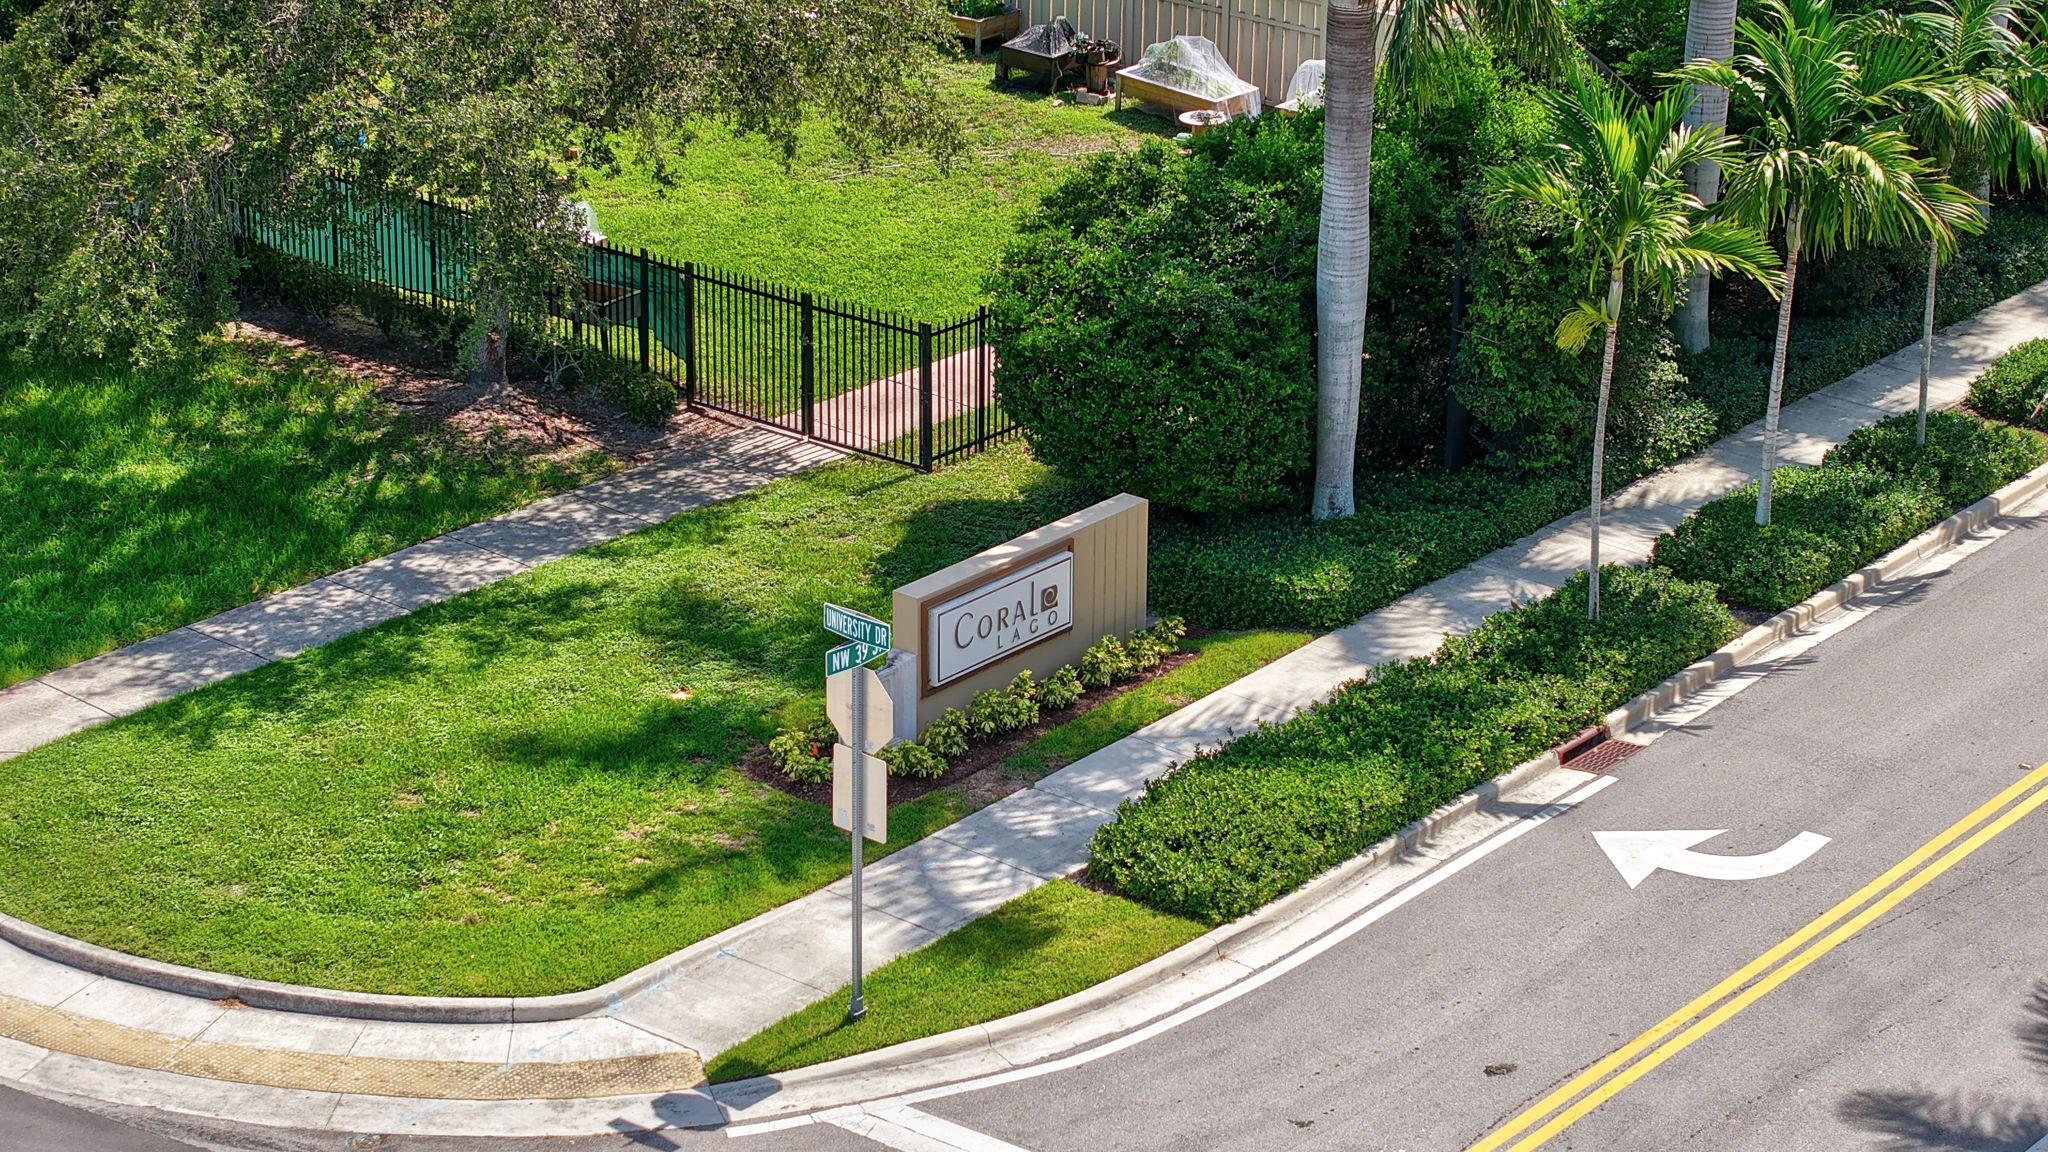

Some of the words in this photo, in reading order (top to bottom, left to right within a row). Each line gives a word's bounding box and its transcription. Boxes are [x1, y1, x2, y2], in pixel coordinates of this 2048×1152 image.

[826, 607, 871, 641] UNIVERSITY
[875, 626, 887, 647] DR
[955, 581, 1038, 649] CORAL
[997, 610, 1058, 650] LAGO
[832, 649, 850, 672] NW
[855, 643, 869, 664] 39
